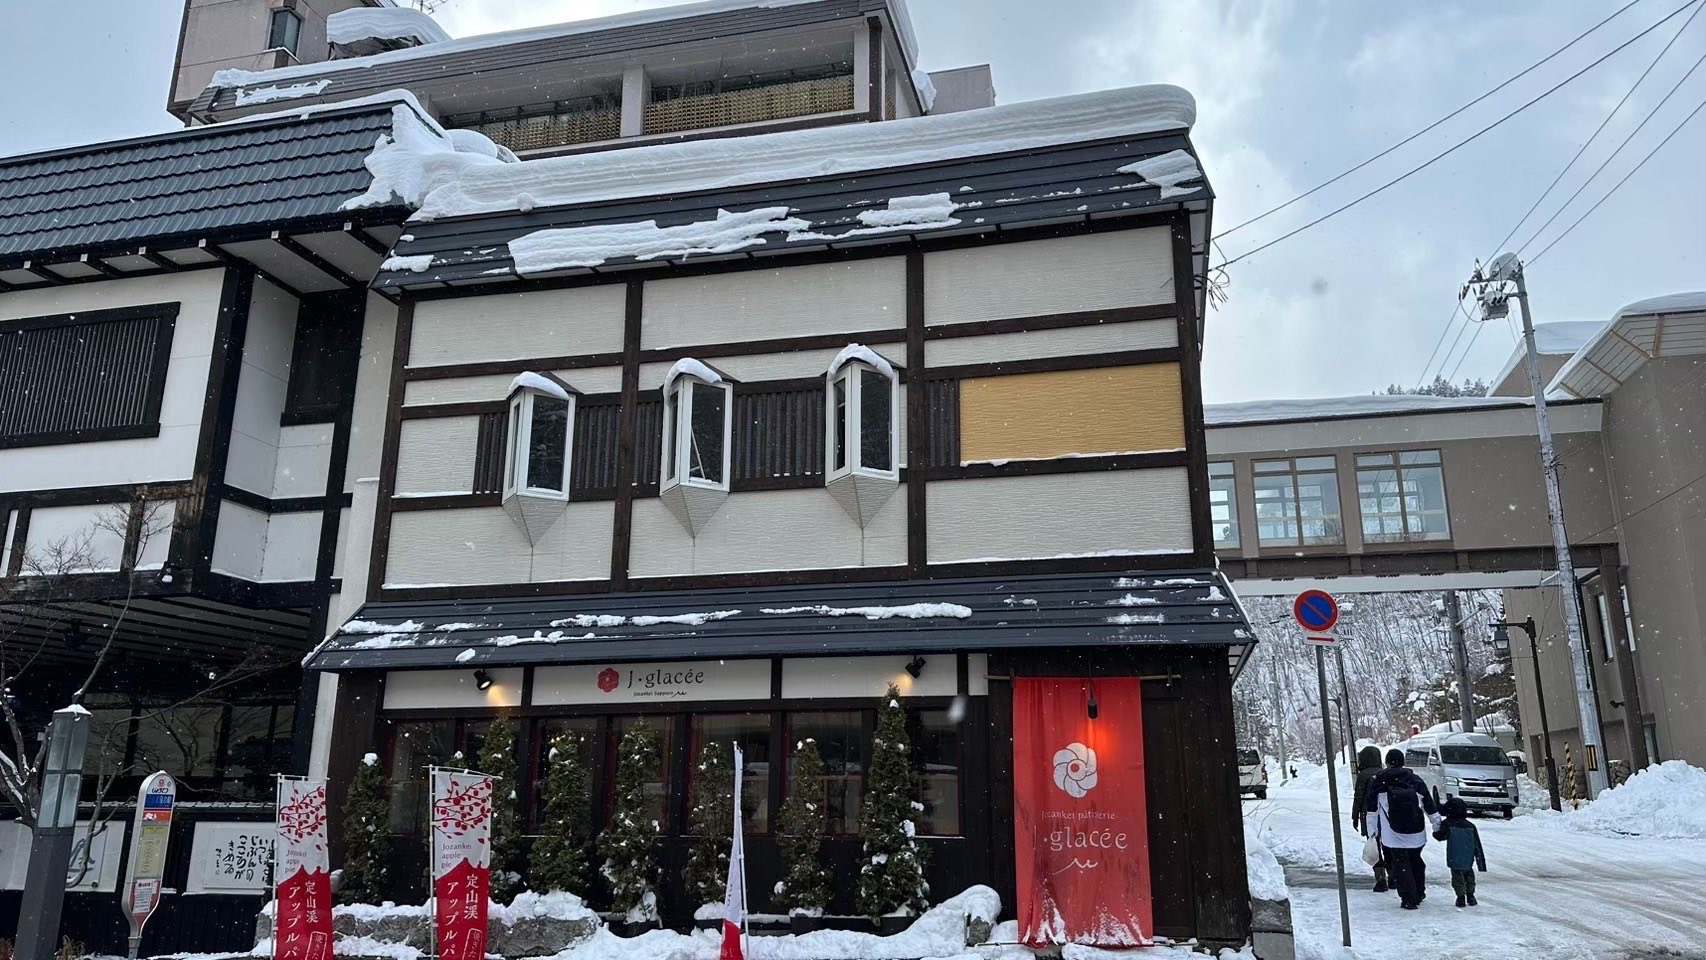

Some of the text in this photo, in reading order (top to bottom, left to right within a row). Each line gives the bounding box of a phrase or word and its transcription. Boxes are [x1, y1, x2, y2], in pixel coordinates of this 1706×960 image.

[441, 852, 461, 860] apple
[305, 881, 319, 924] 定山渓
[464, 874, 479, 920] 定山渓
